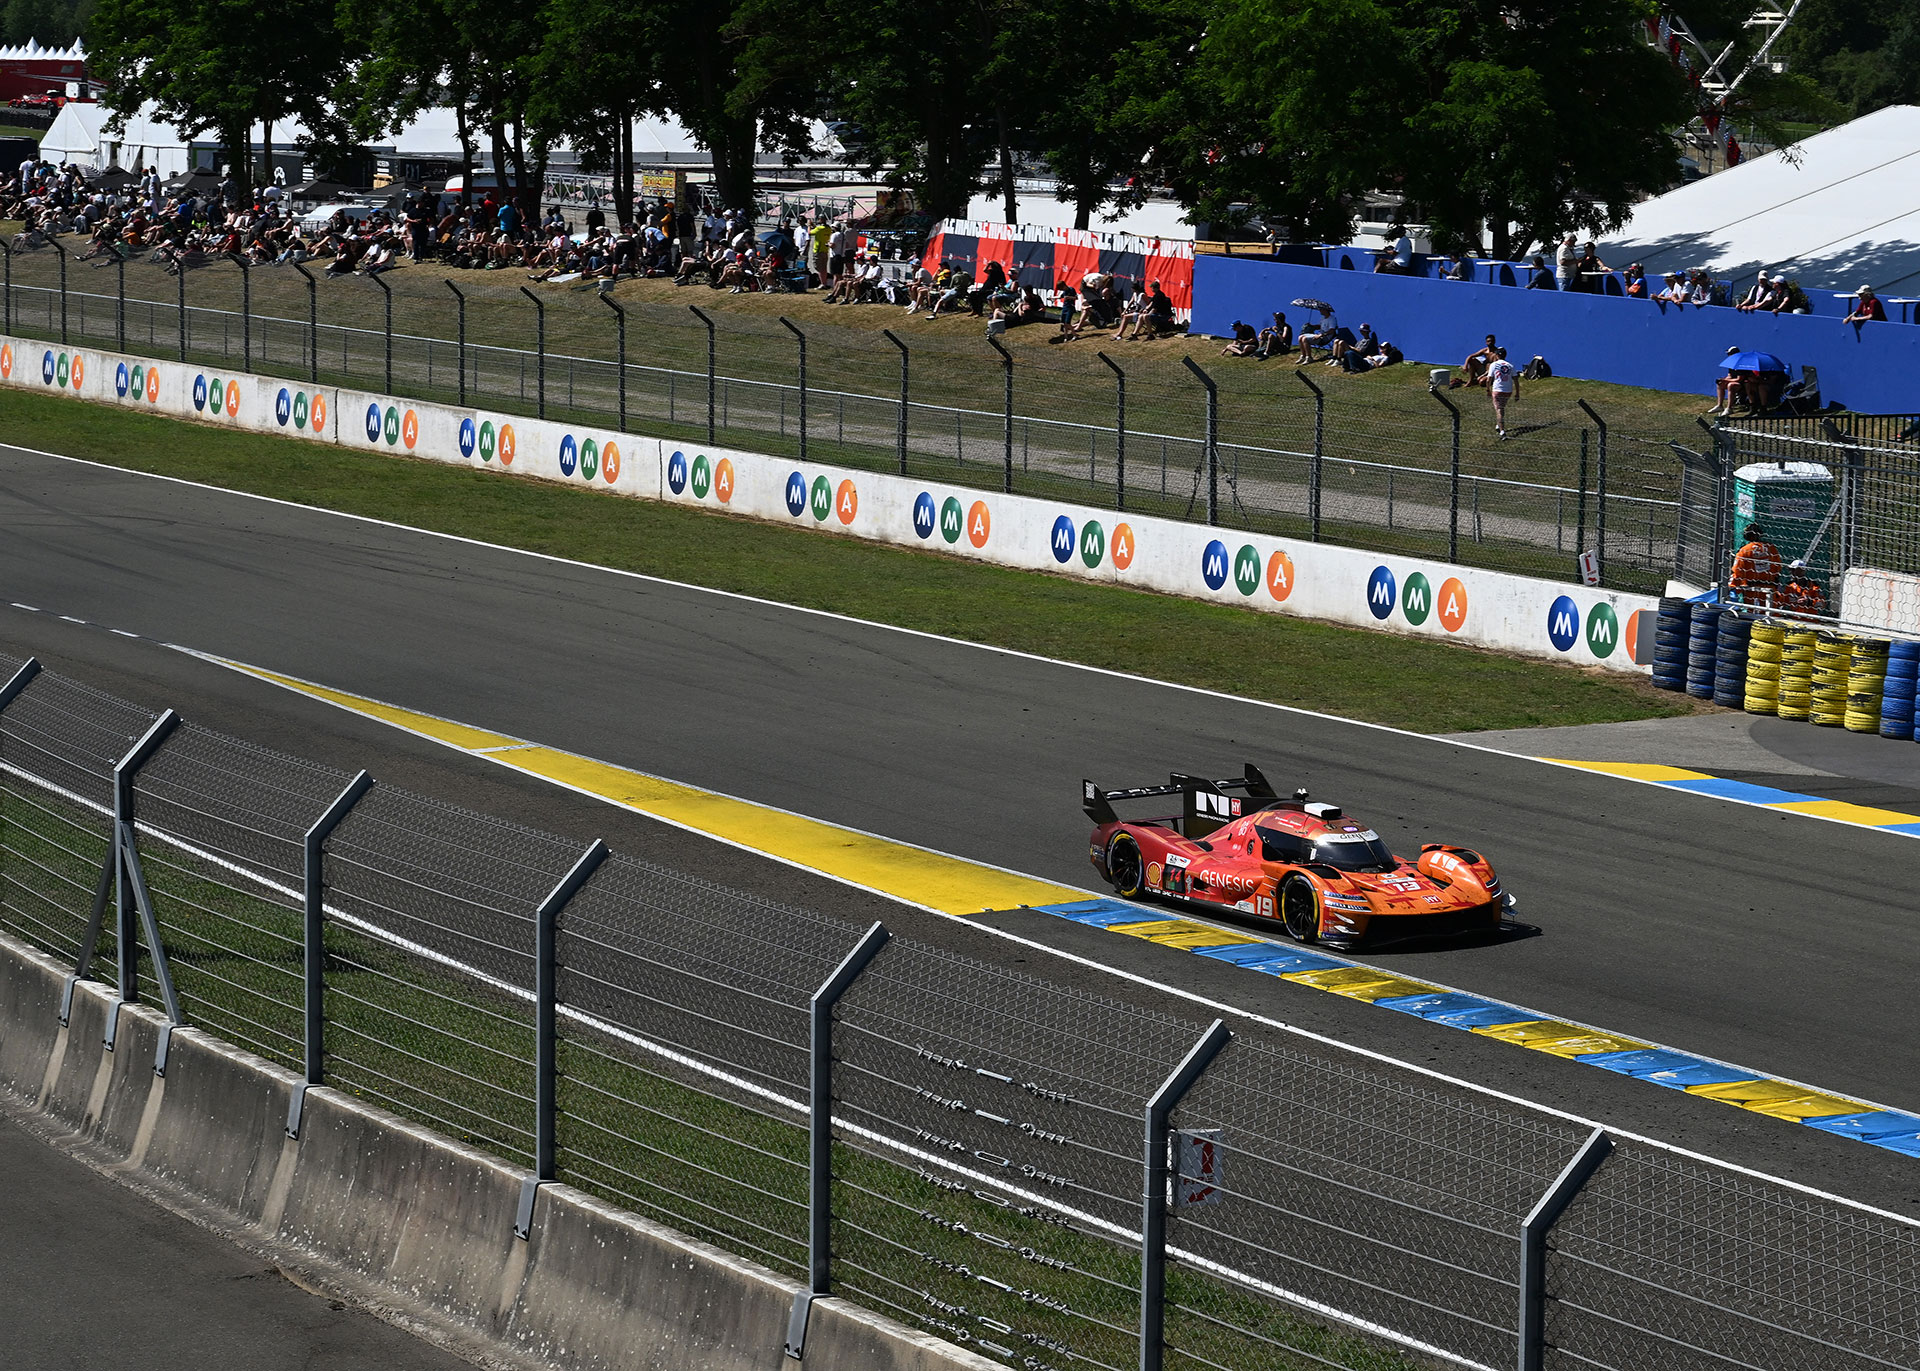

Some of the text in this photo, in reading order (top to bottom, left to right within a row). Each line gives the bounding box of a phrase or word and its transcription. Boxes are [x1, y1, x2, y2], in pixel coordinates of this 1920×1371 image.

[44, 360, 81, 381] MMA
[116, 372, 157, 393] MMA
[194, 385, 237, 409] MMA
[277, 399, 323, 423] MMA
[367, 414, 415, 439] MMA
[461, 429, 512, 455] MMA
[561, 446, 616, 473] MMA
[670, 463, 729, 492] MMA
[788, 484, 852, 513] MMA
[916, 505, 985, 537] MMA
[1054, 528, 1129, 558] MMA
[1206, 554, 1287, 588] MMA
[1371, 581, 1460, 618] MMA
[1552, 611, 1638, 649] MM
[1170, 867, 1183, 883] 14
[1200, 869, 1255, 894] GENESIS
[1392, 881, 1422, 892] 19
[1256, 895, 1273, 917] 19
